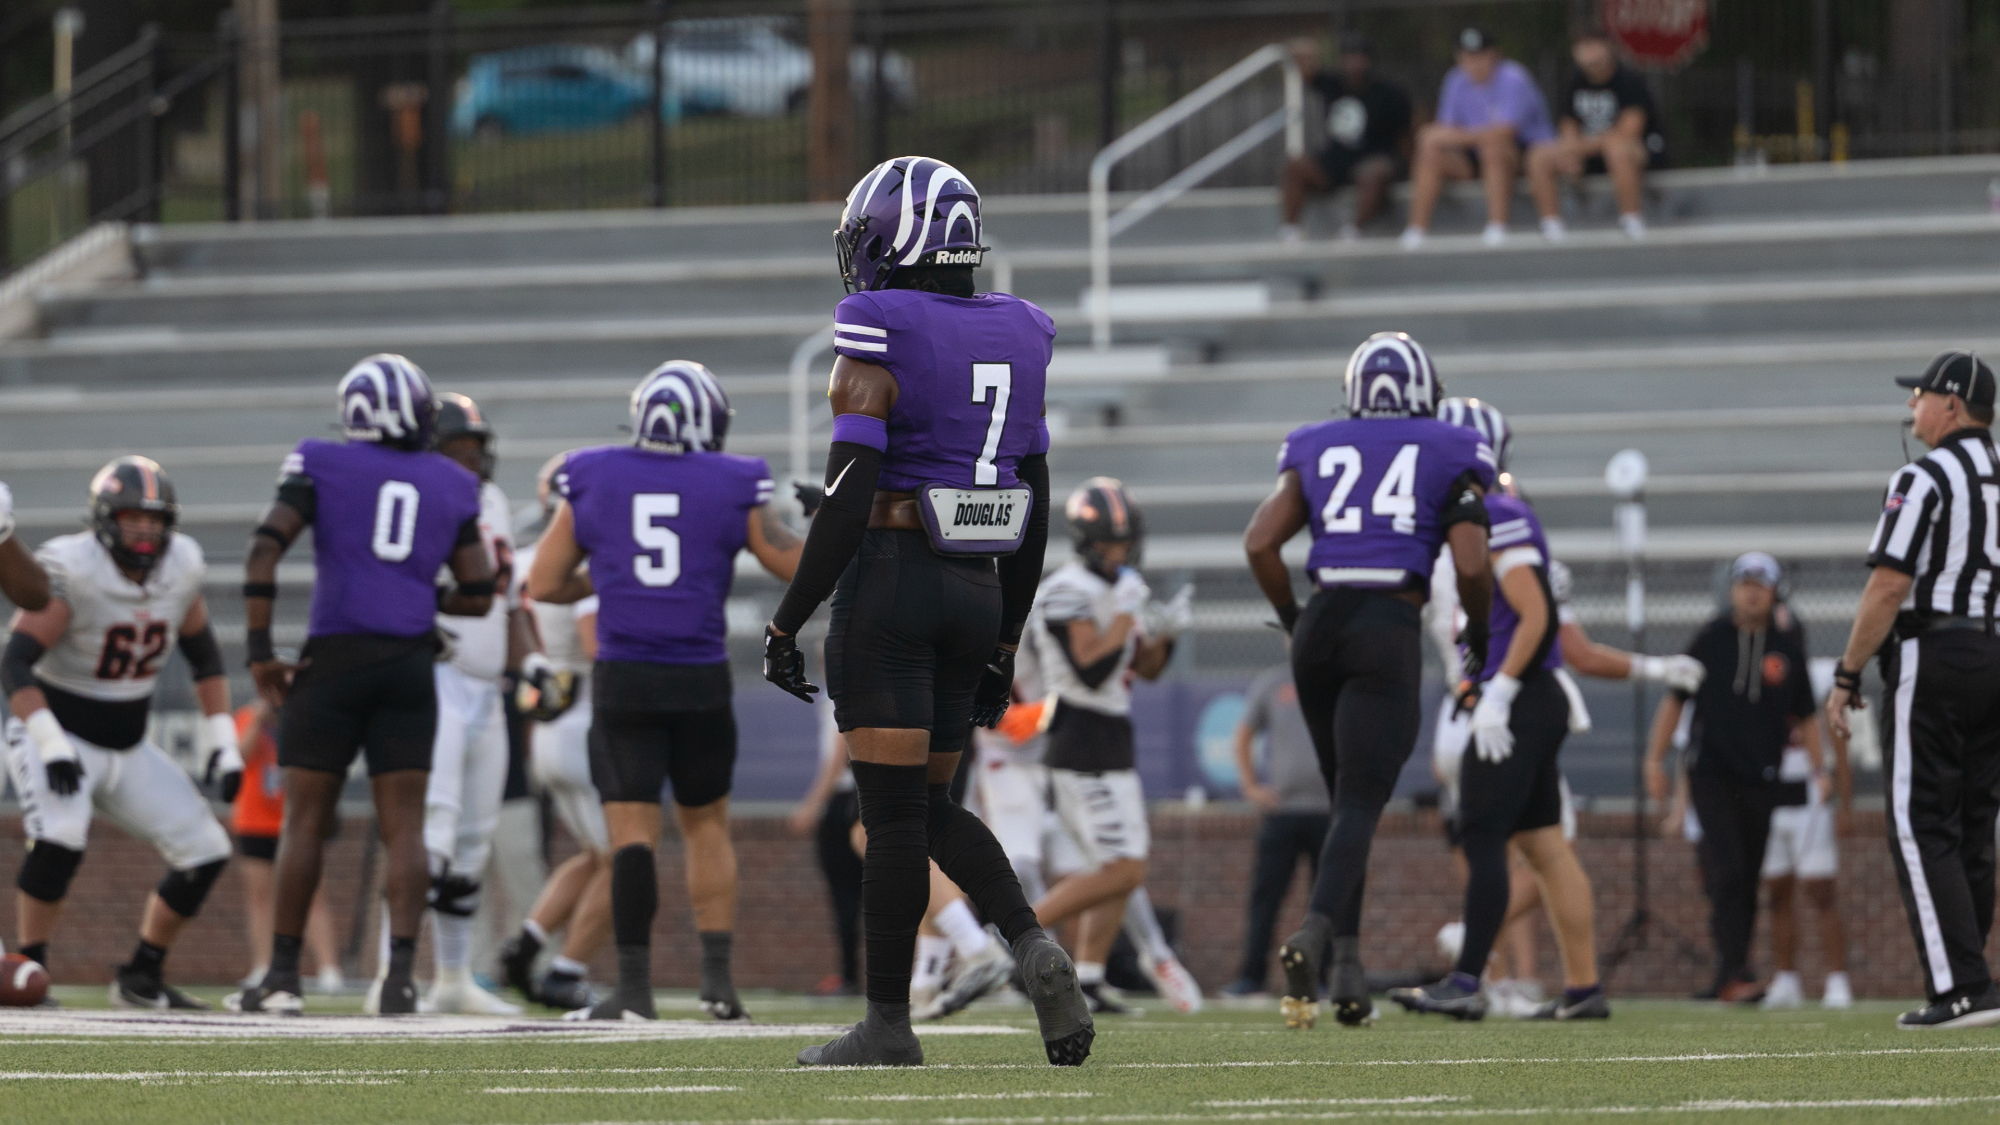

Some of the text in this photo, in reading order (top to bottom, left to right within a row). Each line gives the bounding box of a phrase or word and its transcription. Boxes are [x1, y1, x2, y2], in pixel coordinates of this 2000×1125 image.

[953, 181, 962, 190] 7
[935, 250, 981, 265] Riddell
[970, 361, 1012, 488] 7
[371, 479, 421, 562] 0
[953, 502, 1013, 527] DOUGLAS
[1318, 443, 1420, 535] 24
[632, 493, 681, 587] 5
[95, 622, 168, 680] 62
